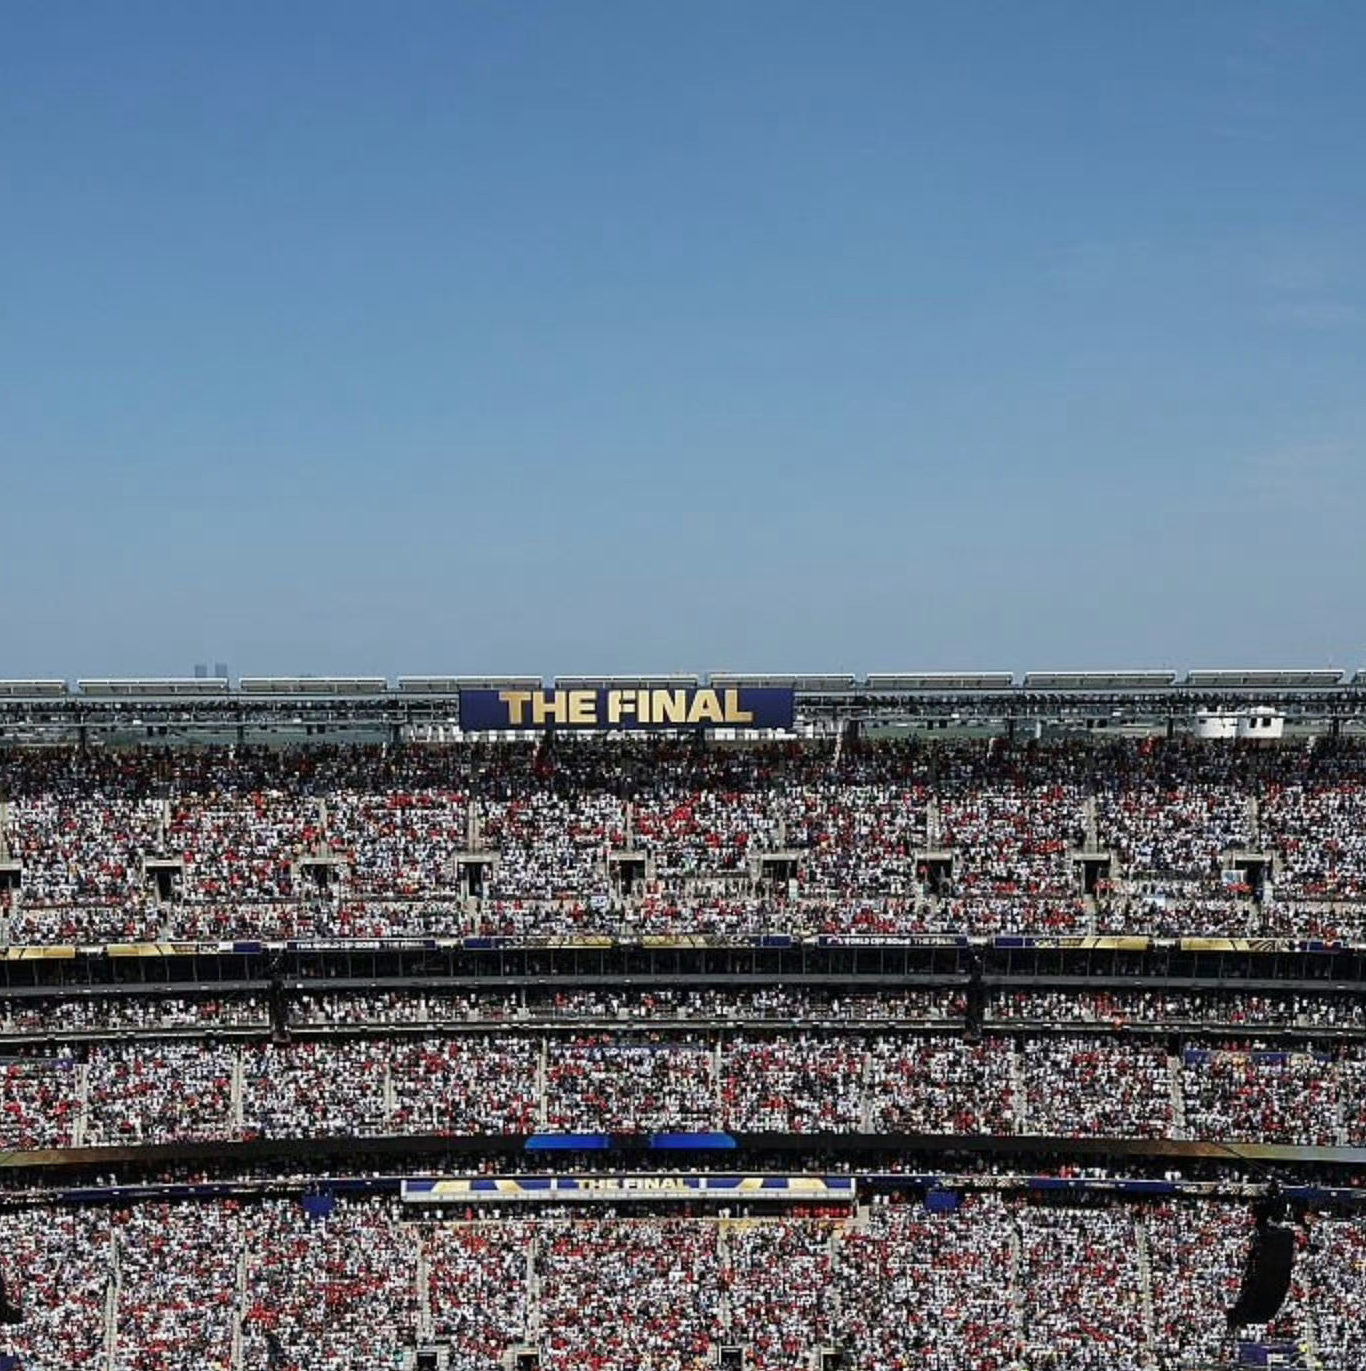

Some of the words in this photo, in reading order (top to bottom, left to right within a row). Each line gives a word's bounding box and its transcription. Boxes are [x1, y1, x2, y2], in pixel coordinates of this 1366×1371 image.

[499, 690, 597, 724] THE
[608, 689, 753, 723] FINAL
[573, 1178, 620, 1191] THE
[622, 1178, 691, 1192] FINAL
